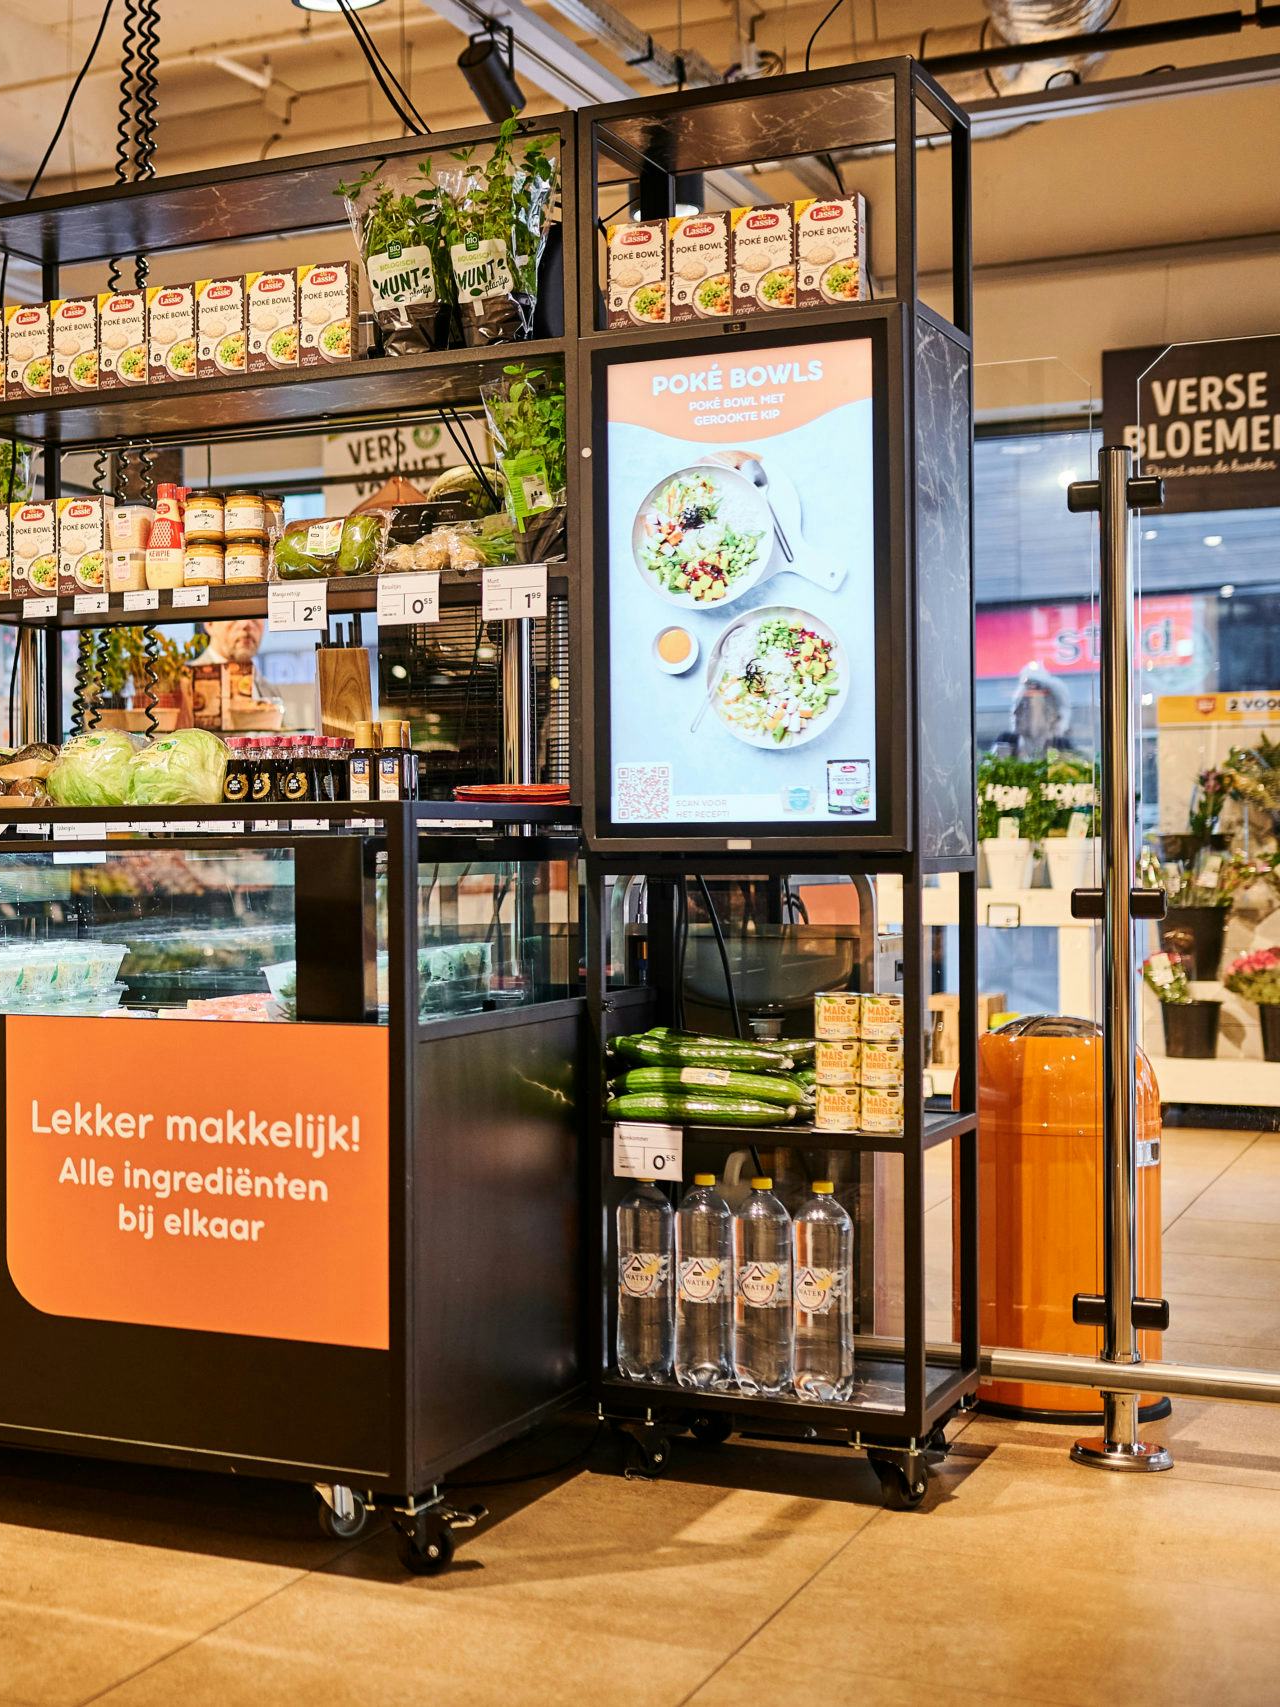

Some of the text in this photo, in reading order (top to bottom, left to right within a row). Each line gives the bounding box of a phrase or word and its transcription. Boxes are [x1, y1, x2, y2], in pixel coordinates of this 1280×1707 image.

[813, 208, 840, 219] Lassie
[749, 217, 776, 228] Lassie
[686, 225, 712, 236] Lassie
[802, 226, 852, 237] POKÉ BOWL
[466, 236, 478, 245] BIO
[623, 233, 649, 243] Lassie
[739, 234, 788, 246] POKÉ BOWL
[676, 242, 723, 254] POKÉ BOWL
[612, 250, 660, 261] POKÉ BOWL
[453, 259, 496, 290] MUNT
[379, 267, 420, 300] MUNT
[324, 289, 345, 298] BOWL
[271, 297, 292, 305] BOWL
[220, 304, 240, 312] BOWL
[171, 310, 191, 319] BOWL
[122, 317, 141, 325] BOWL
[74, 323, 93, 331] BOWL
[28, 329, 46, 337] BOWL
[652, 360, 824, 396] POKÉ BOWLS
[1152, 371, 1268, 416] VERSE
[688, 393, 785, 411] POKÉ BOWL MET
[694, 409, 781, 426] GEROOKTE KIP
[32, 526, 51, 534] BOWL
[80, 522, 99, 530] BOWL
[149, 549, 171, 558] KEWPIE
[32, 1100, 360, 1159] Lekker makkelijk!
[58, 1156, 329, 1203] Alle ingrediënten
[118, 1203, 265, 1242] bij elkaar
[625, 1273, 651, 1282] WATER
[685, 1277, 712, 1287] WATER
[744, 1283, 771, 1292] WATER
